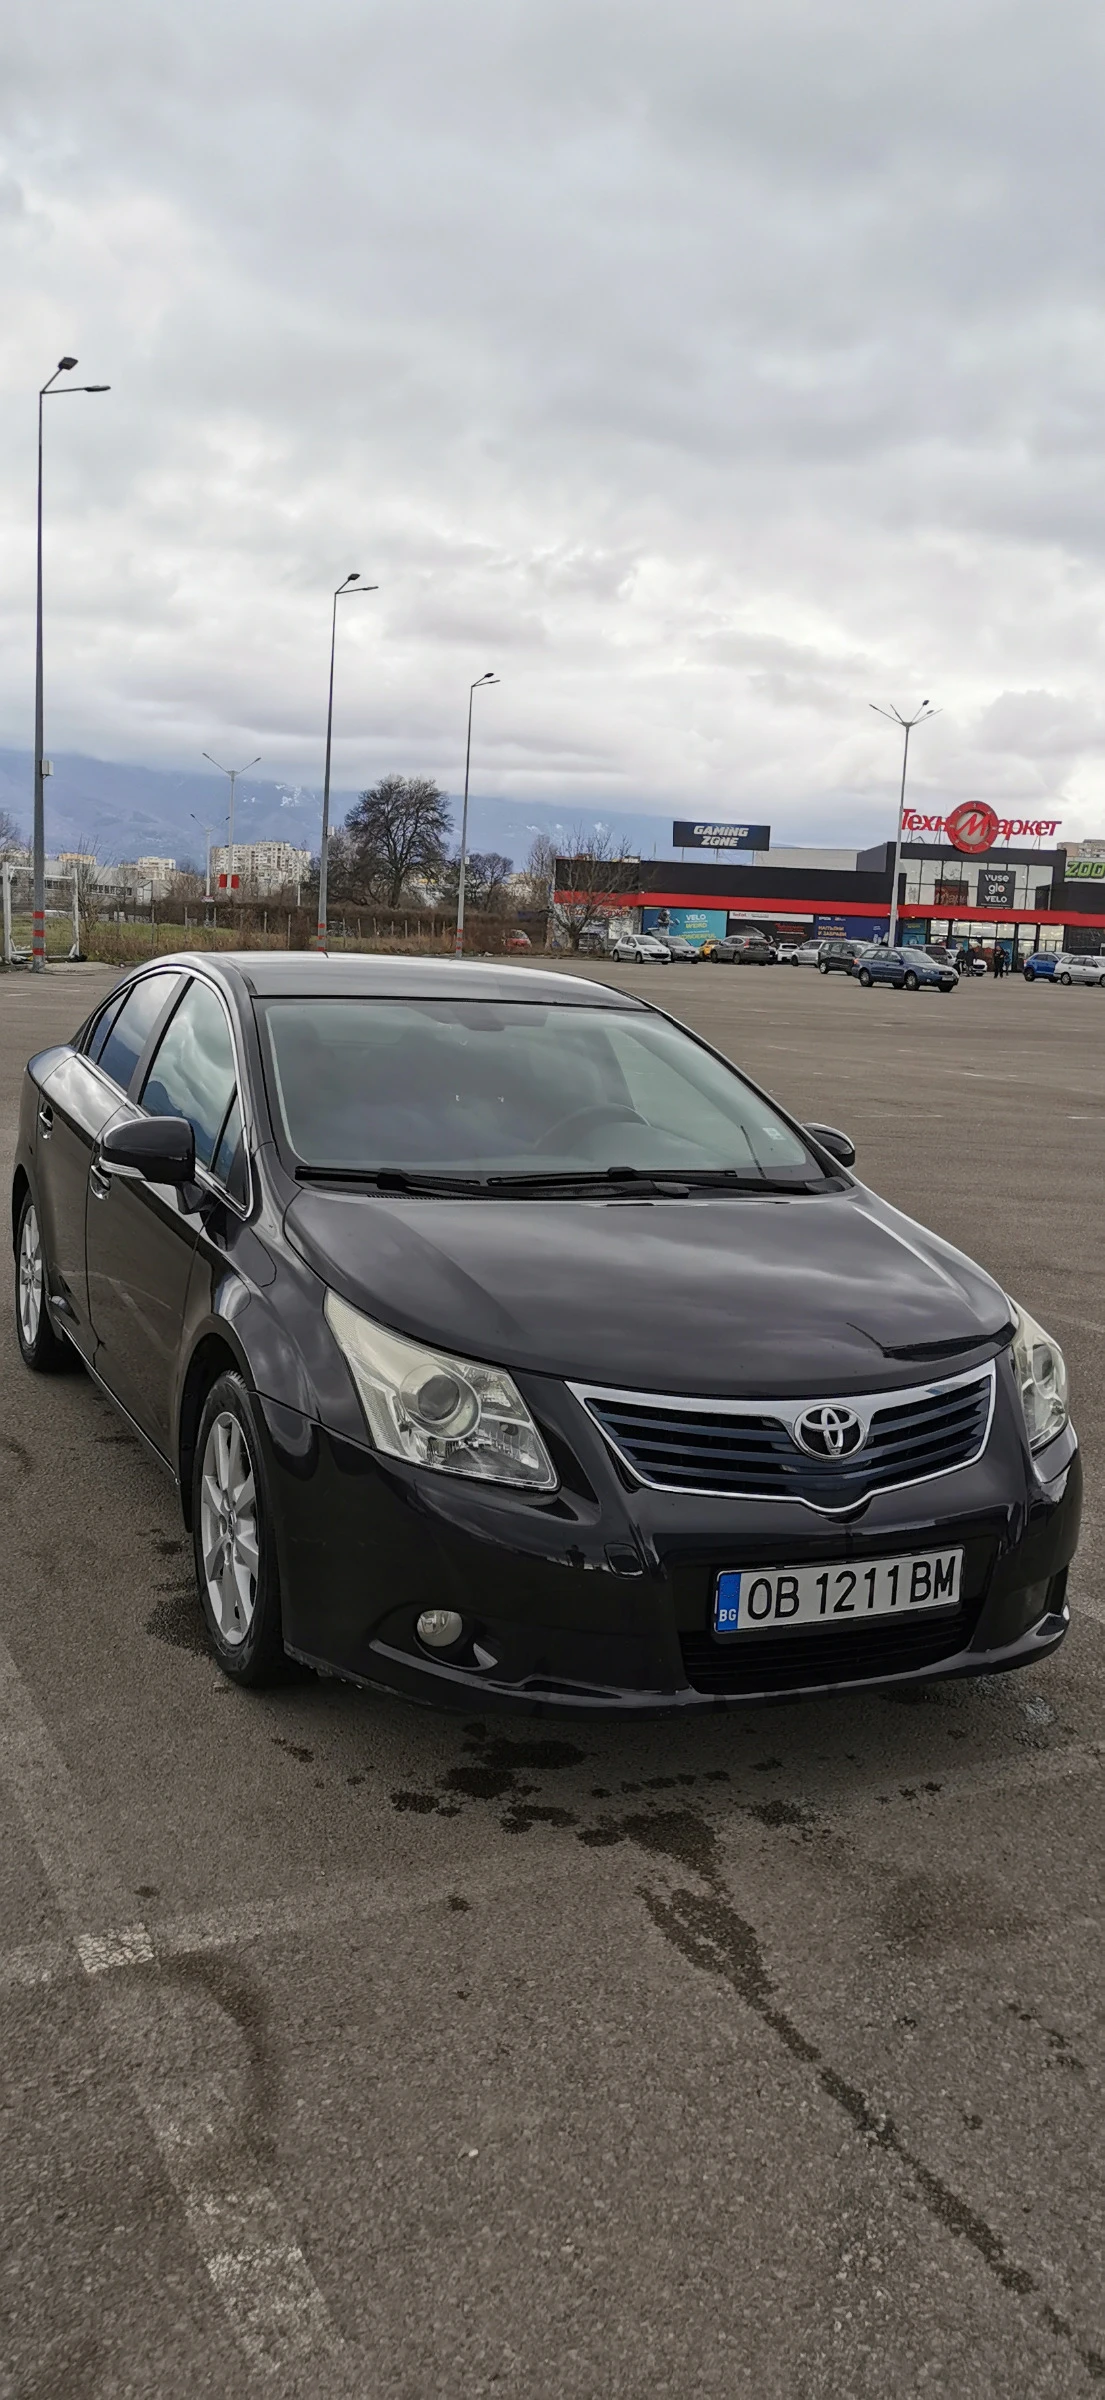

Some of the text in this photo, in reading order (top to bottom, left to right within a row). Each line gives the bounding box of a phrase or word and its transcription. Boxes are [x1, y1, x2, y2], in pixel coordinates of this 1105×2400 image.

[693, 825, 750, 837] GAMING
[701, 835, 739, 847] ZONE
[988, 883, 1005, 895] glo
[984, 895, 1008, 903] VELO
[685, 913, 707, 921] VELO
[747, 1555, 957, 1620] OB 1211 BM
[718, 1608, 737, 1622] BG
